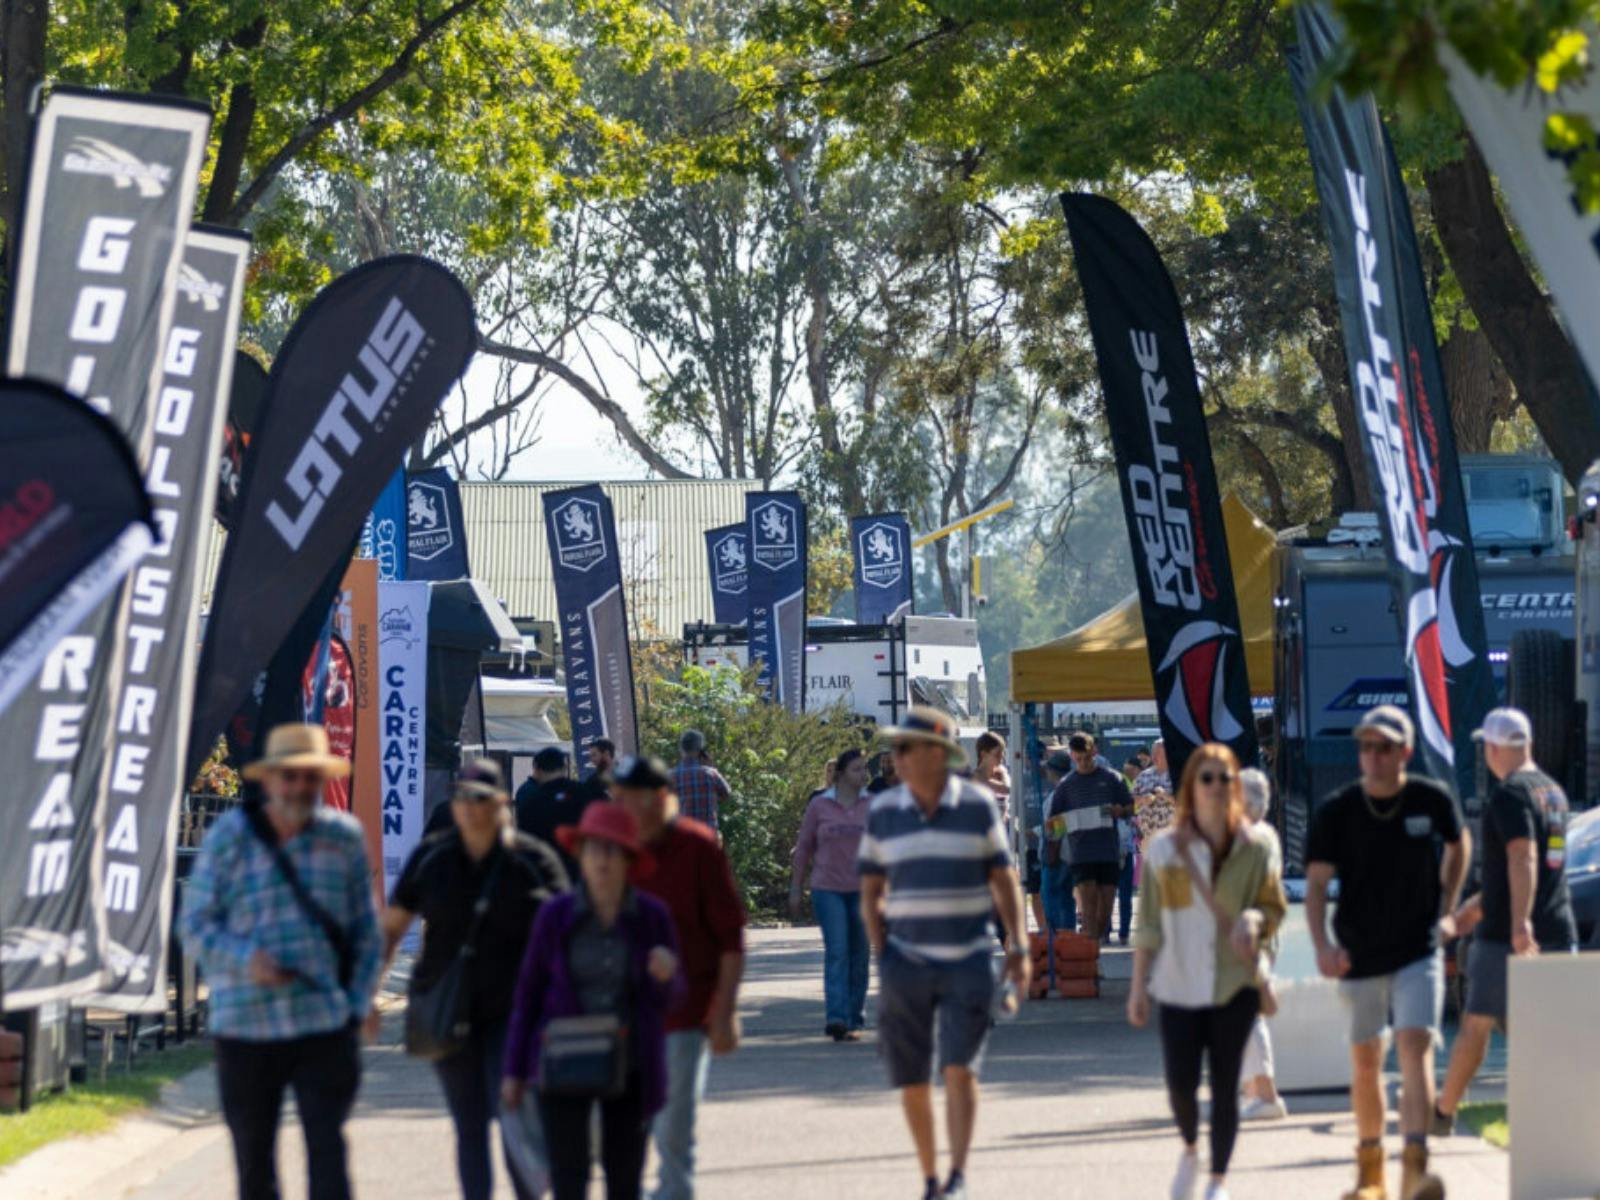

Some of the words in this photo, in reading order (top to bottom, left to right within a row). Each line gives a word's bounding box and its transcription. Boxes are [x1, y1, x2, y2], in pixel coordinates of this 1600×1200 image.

[264, 296, 427, 551] LOTUS
[374, 336, 436, 434] CARAVANS
[1130, 328, 1202, 611] CENTRE
[27, 216, 137, 897] GOREAM
[1128, 464, 1180, 607] RED
[1481, 592, 1577, 608] CENTR
[1498, 610, 1573, 619] CARAVA
[567, 613, 592, 725] CARAVANS
[811, 674, 852, 689] FLAIR
[383, 665, 405, 836] CARAVAN
[407, 706, 418, 796] CENTRE
